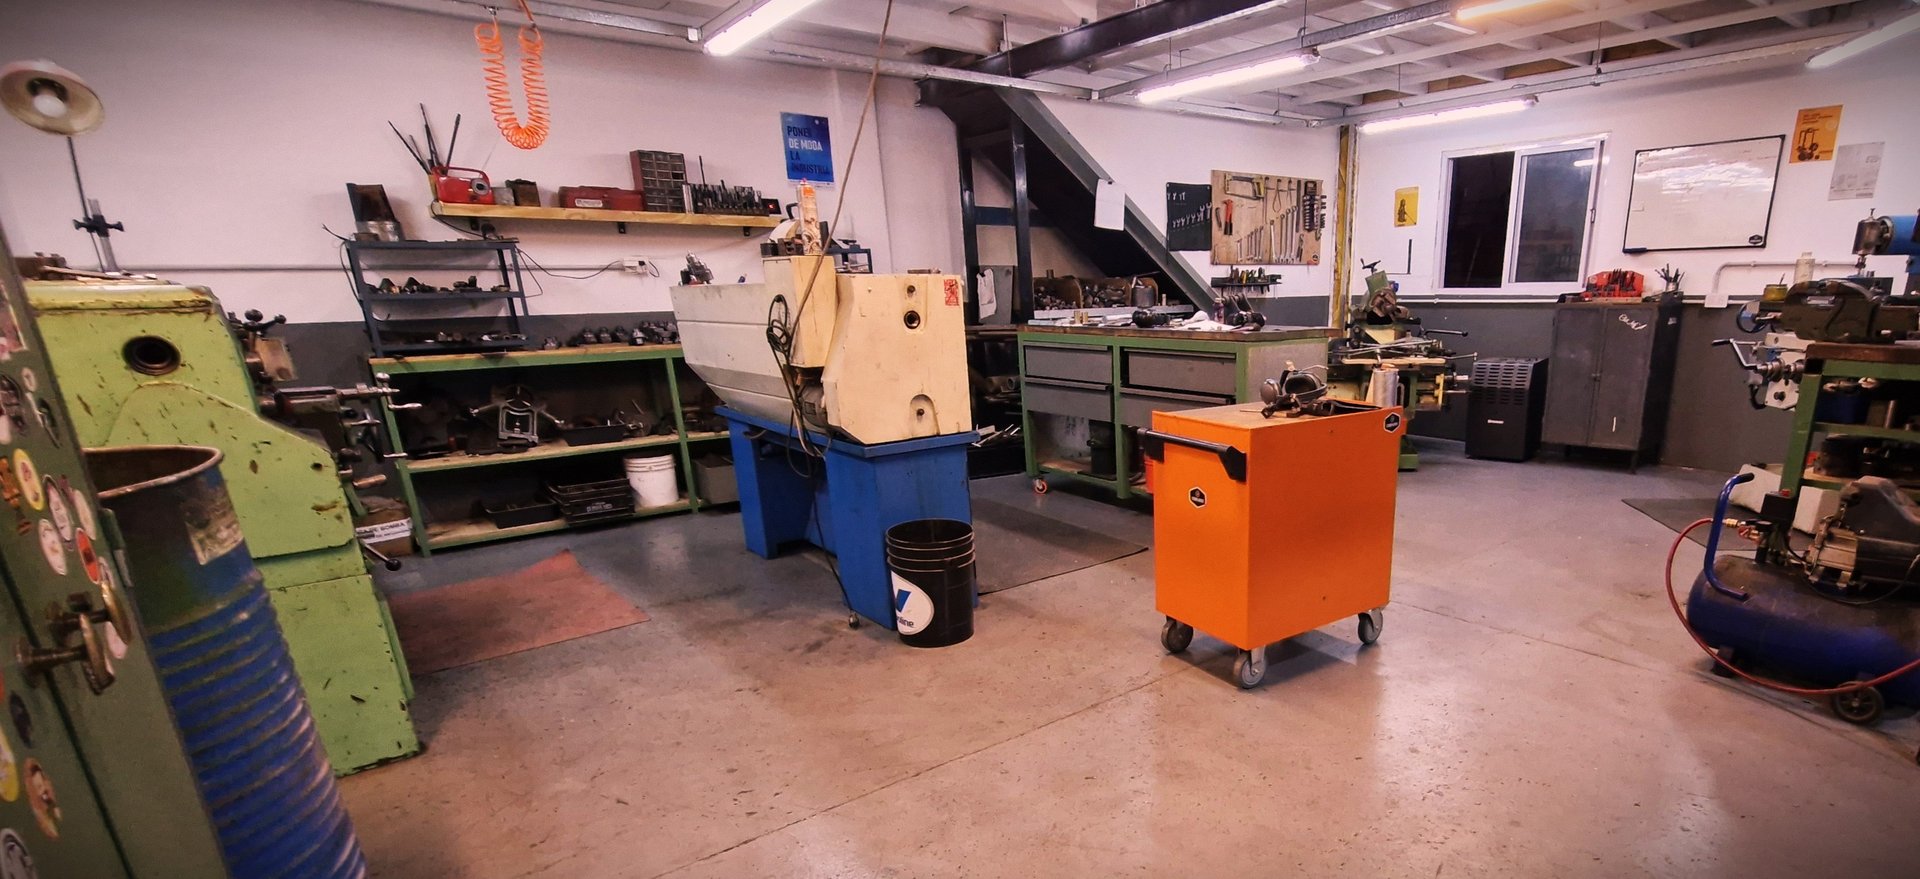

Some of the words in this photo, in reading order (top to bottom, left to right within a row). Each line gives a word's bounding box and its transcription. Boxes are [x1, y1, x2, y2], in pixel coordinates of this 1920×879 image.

[789, 138, 799, 149] DE
[801, 139, 823, 151] MODA
[790, 151, 801, 161] LA
